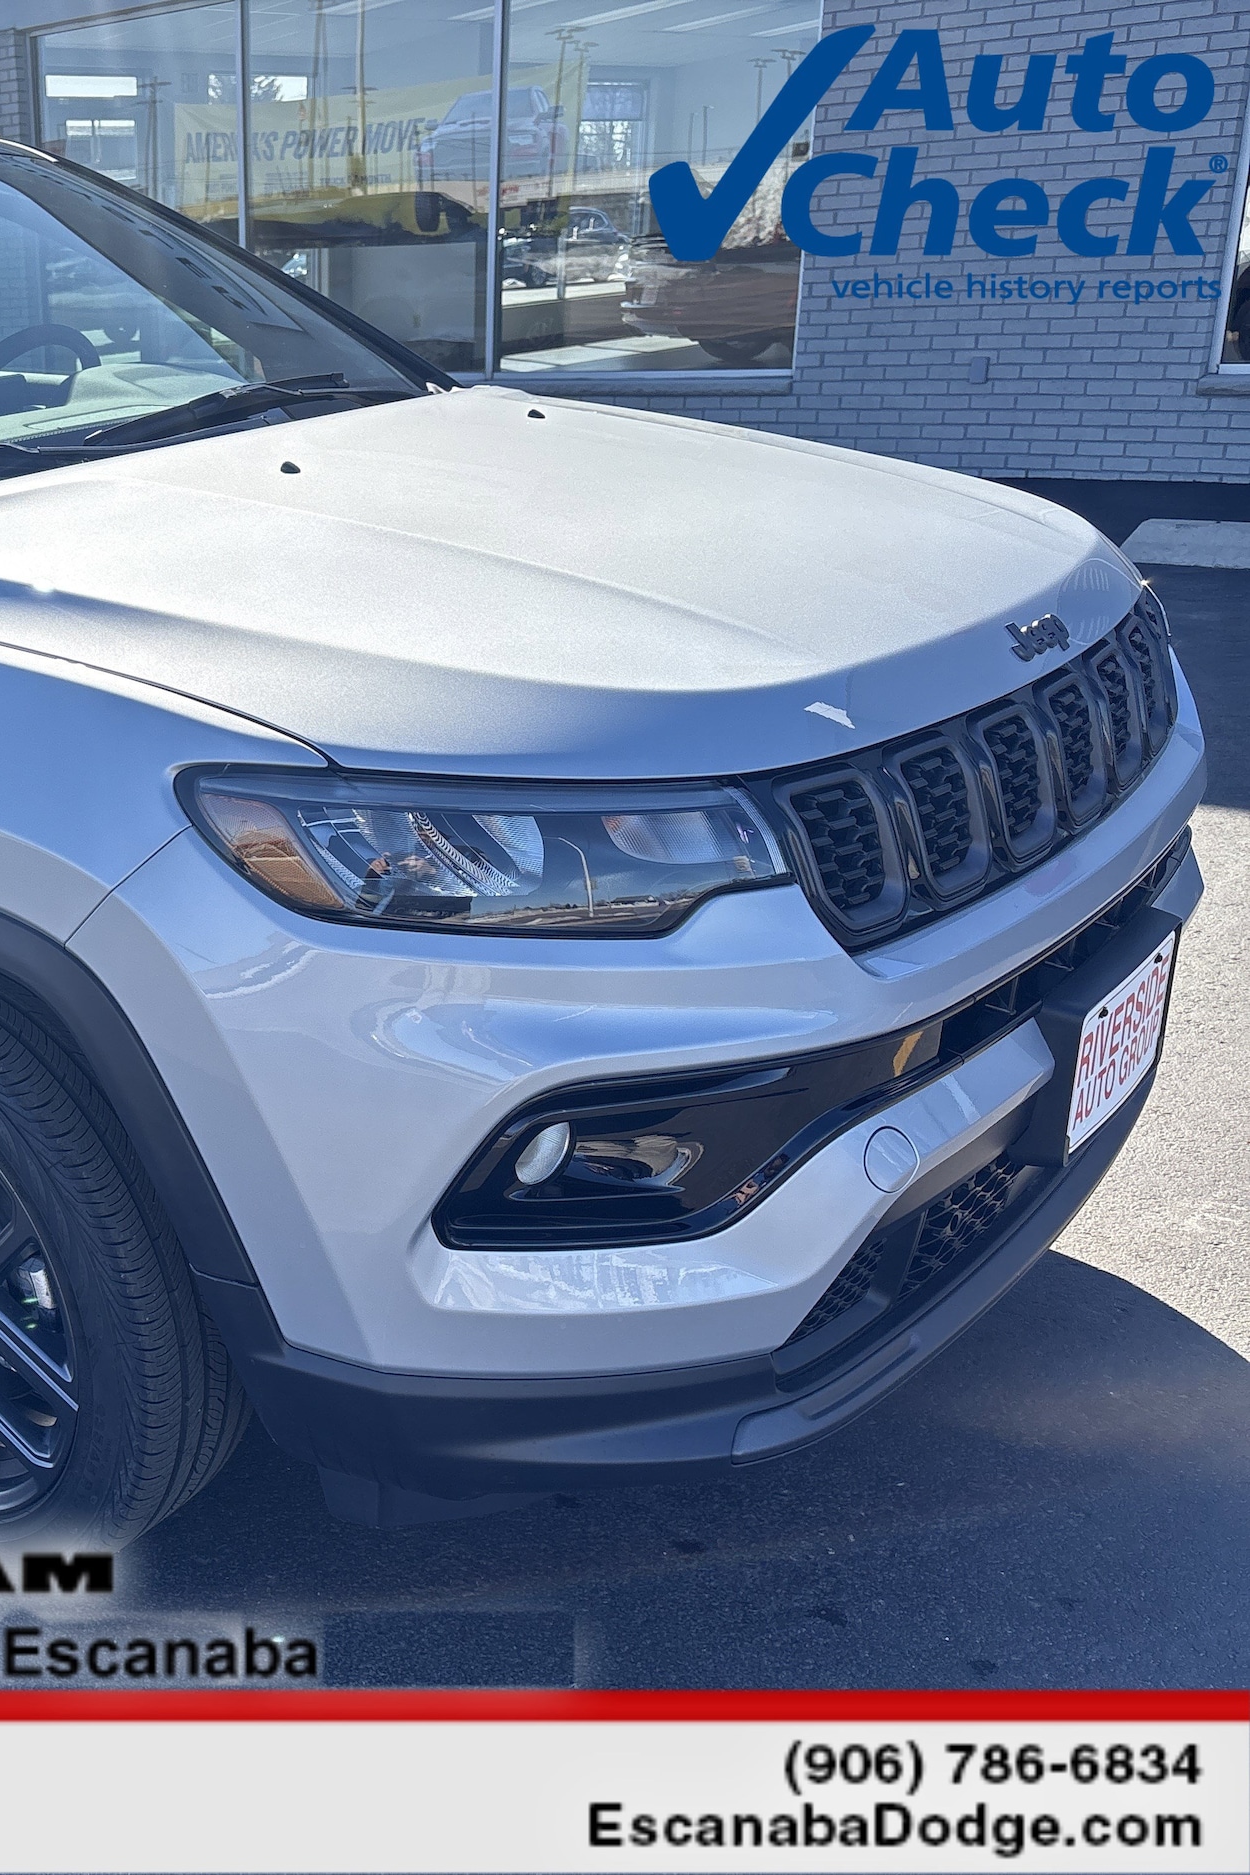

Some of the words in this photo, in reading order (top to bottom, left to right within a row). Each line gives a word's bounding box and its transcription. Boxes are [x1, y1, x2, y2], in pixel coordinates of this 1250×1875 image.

[279, 125, 359, 161] POWER
[1004, 613, 1071, 662] Jeep
[1076, 954, 1170, 1089] RIVERSIDE
[1072, 1059, 1117, 1131] AUTO
[1118, 1007, 1161, 1086] GROUP
